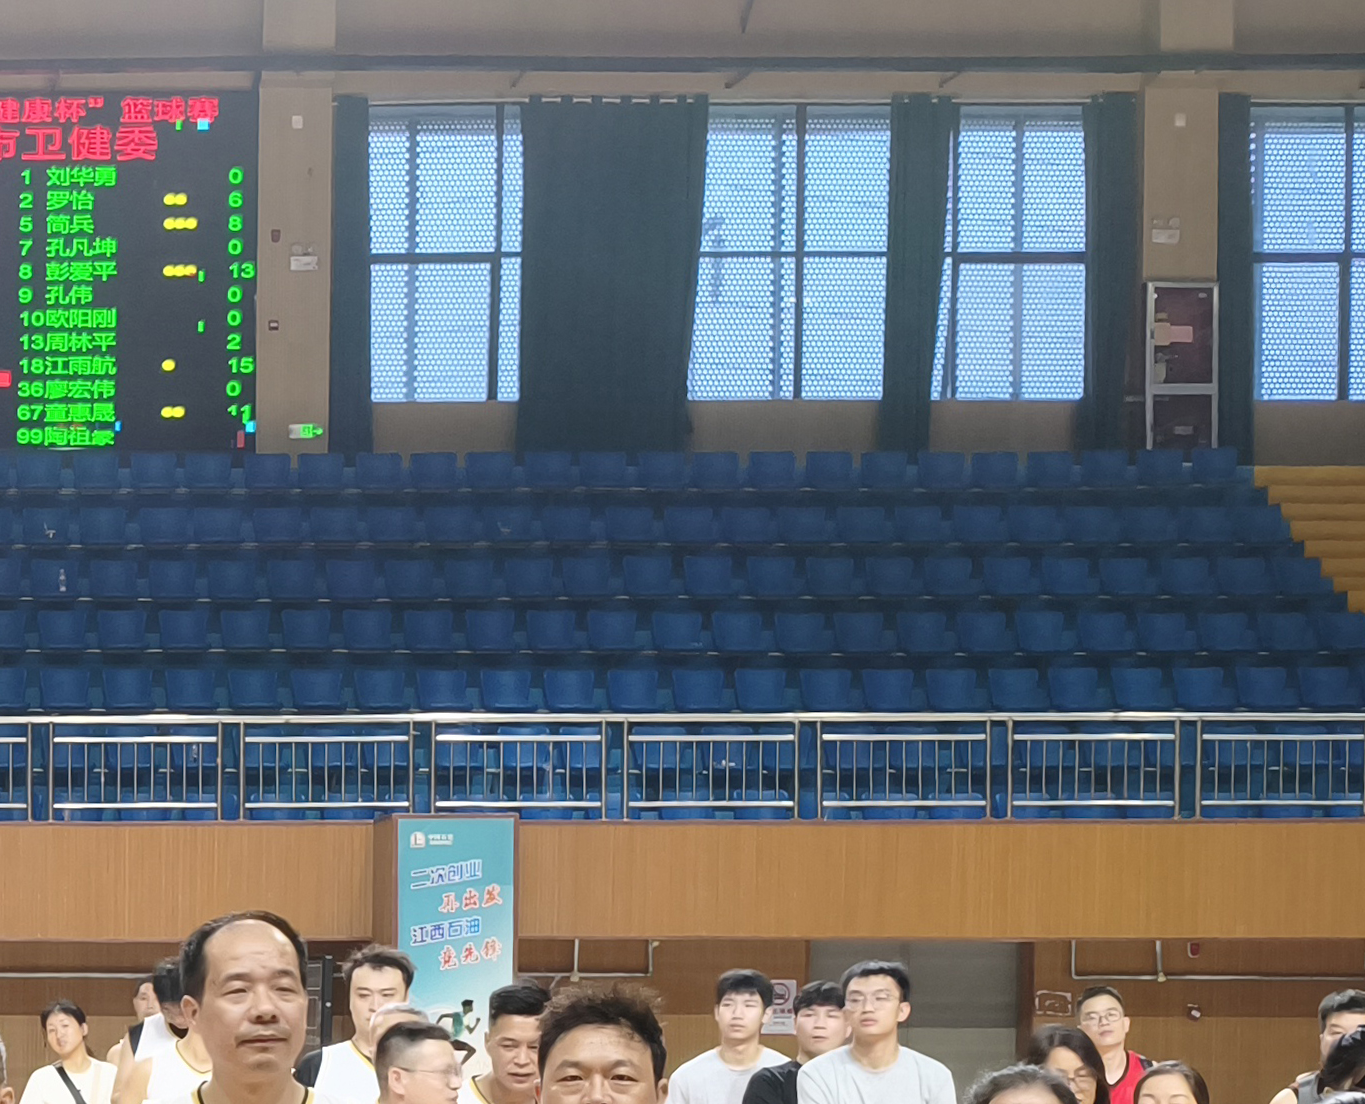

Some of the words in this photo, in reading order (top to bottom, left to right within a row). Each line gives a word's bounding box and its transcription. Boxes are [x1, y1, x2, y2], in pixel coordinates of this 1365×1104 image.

[20, 168, 31, 185] 1
[46, 165, 117, 187] 刘华勇
[228, 166, 244, 184] 0
[19, 192, 33, 209] 2
[46, 190, 94, 210] 罗怡
[228, 191, 243, 208] 6
[19, 216, 33, 233] 5
[46, 214, 94, 234] 简兵
[228, 214, 243, 232] 8
[19, 239, 33, 257] 7
[45, 236, 117, 258] 孔凡坤
[228, 238, 243, 255] 0
[18, 263, 33, 280] 8
[45, 261, 117, 282] 彭爱平
[229, 261, 255, 279] 13
[18, 286, 33, 304] 9
[45, 285, 93, 305] 孔伟
[227, 285, 243, 303] 0
[19, 310, 45, 328] 10
[45, 307, 117, 329] 欧阳刚
[227, 309, 242, 327] 0
[19, 334, 45, 351] 13
[45, 331, 117, 352] 周林平
[227, 333, 242, 350] 2
[19, 358, 45, 375] 18
[45, 355, 117, 376] 江雨航
[228, 356, 255, 374] 15
[17, 381, 44, 399] 36
[45, 379, 116, 399] 廖宏伟
[226, 380, 242, 398] 0
[17, 404, 44, 422] 67
[16, 428, 44, 446] 99
[411, 859, 482, 889] 二次创业
[439, 884, 502, 914] 再出发
[411, 916, 481, 946] 江西石油
